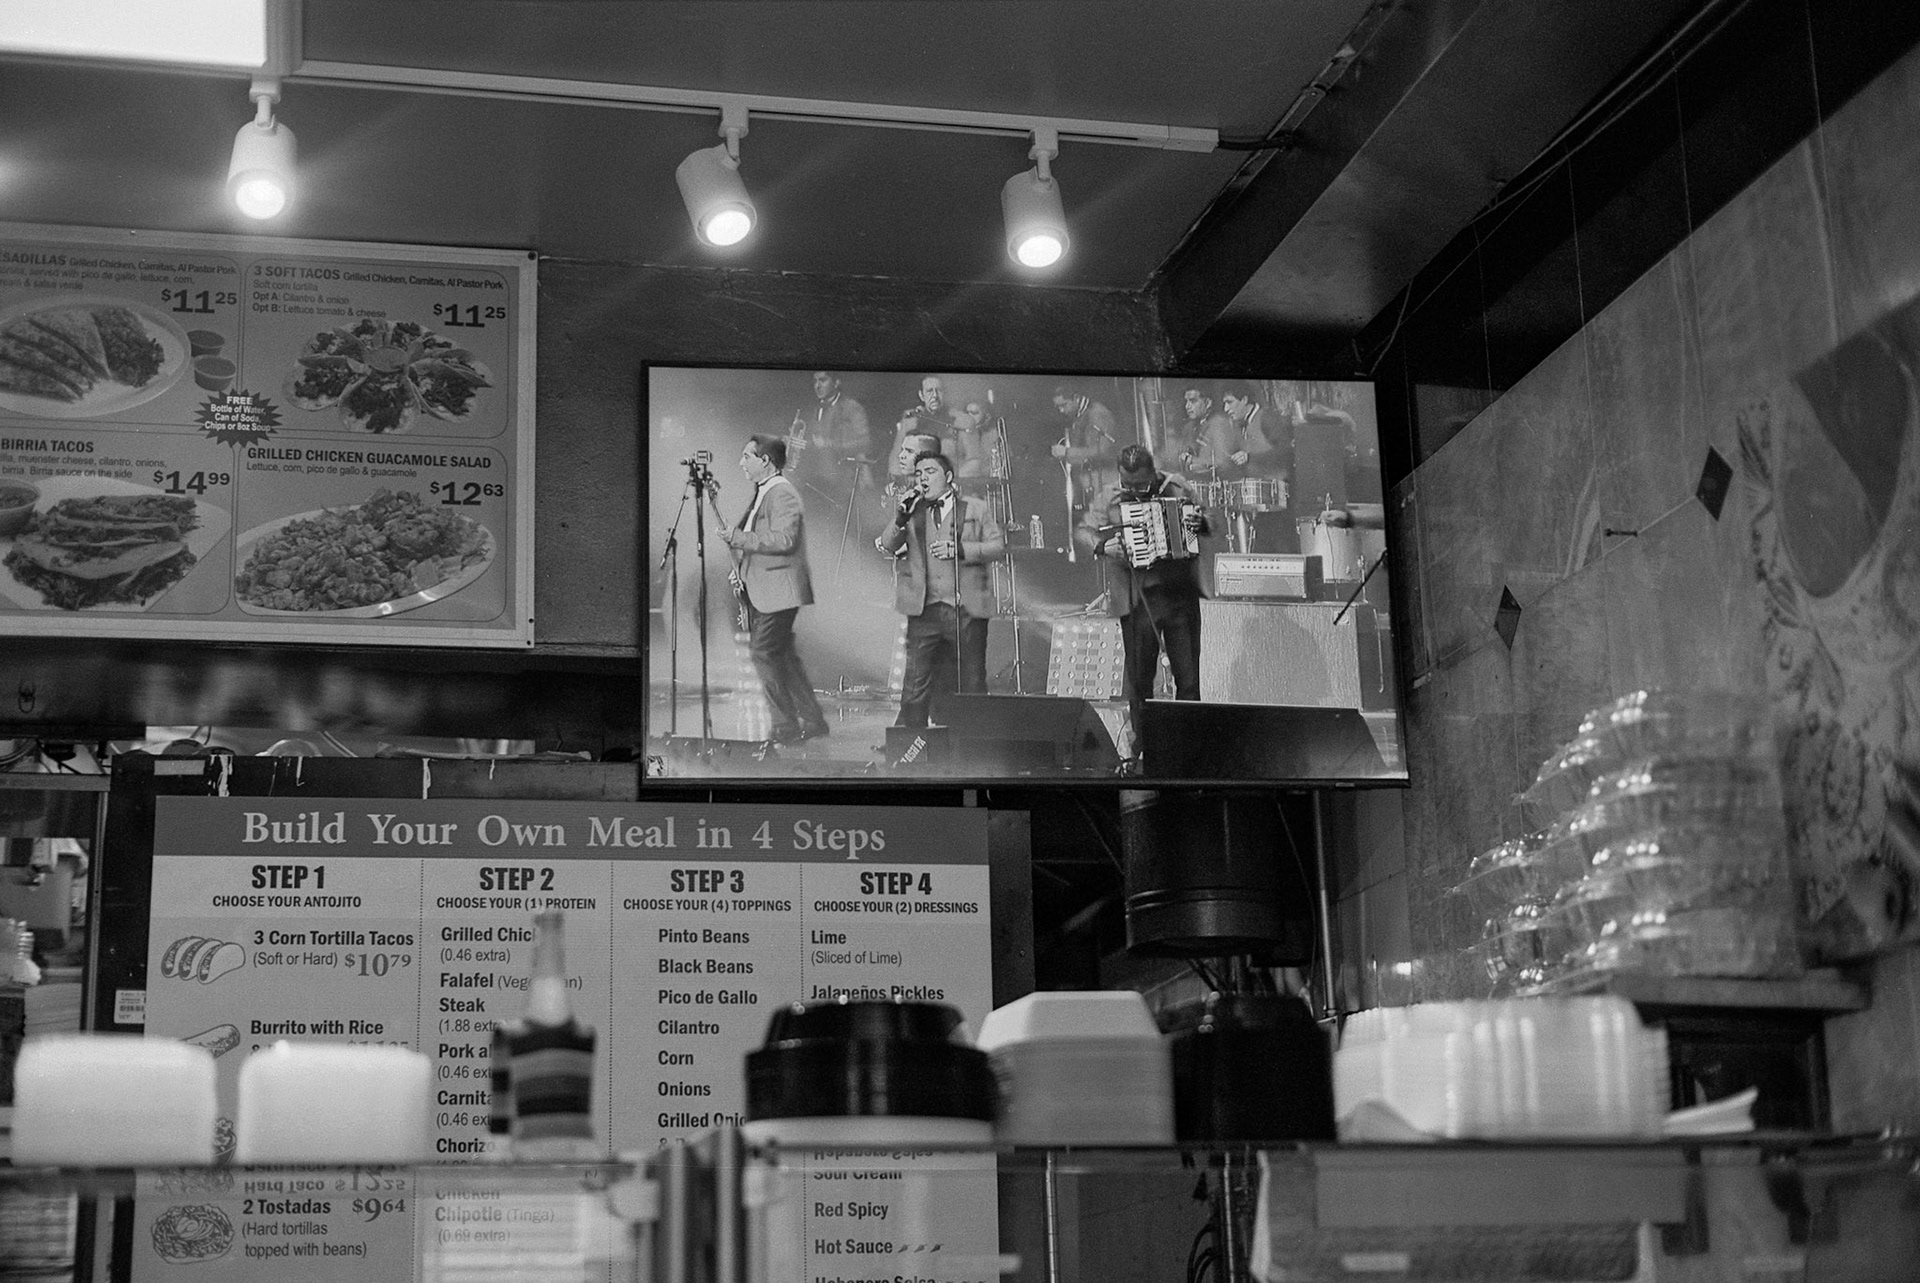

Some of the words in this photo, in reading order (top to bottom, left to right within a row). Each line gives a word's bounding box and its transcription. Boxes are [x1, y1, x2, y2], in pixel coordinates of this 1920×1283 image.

[188, 264, 216, 274] Pastor
[217, 265, 237, 275] Pork
[253, 265, 262, 276] 3
[265, 266, 297, 278] SOFT
[300, 267, 341, 280] TACOS
[343, 271, 371, 281] Grilled
[409, 275, 446, 287] Carnitas,
[447, 278, 456, 287] Al
[457, 278, 485, 289] Pastor
[485, 280, 504, 290] Pork
[253, 279, 271, 289] Soft
[272, 281, 291, 290] corn
[252, 291, 269, 302] Opt
[283, 293, 316, 303] Cilantro
[317, 294, 325, 303] &
[252, 302, 269, 313] Opt
[283, 304, 315, 314] Lettuce
[316, 306, 346, 316] tomato
[347, 307, 355, 317] &
[356, 308, 387, 318] cheese
[226, 395, 254, 405] FREE
[210, 404, 233, 413] Bottle
[233, 405, 242, 413] of
[214, 412, 230, 421] Can
[231, 413, 240, 421] of
[204, 420, 226, 431] Chips
[237, 422, 250, 431] 8oz
[251, 422, 271, 432] Soup
[0, 438, 48, 452] BIRRIA
[50, 440, 94, 453] TACOS
[135, 458, 167, 469] onions,
[247, 447, 302, 460] GRILLED
[305, 449, 363, 463] CHICKEN
[366, 452, 447, 467] GUACAMOLE
[450, 455, 492, 469] SALAD
[55, 468, 82, 477] sauce
[84, 469, 96, 477] on
[98, 468, 112, 478] the
[114, 469, 133, 479] side
[246, 461, 281, 473] Lettuce,
[283, 463, 305, 474] corn,
[306, 464, 325, 475] pico
[326, 465, 338, 474] de
[339, 466, 360, 477] gallo
[362, 466, 369, 475] &
[370, 467, 417, 479] guacamole
[242, 810, 347, 844] Build
[366, 813, 458, 845] Your
[477, 814, 567, 847] Own
[586, 816, 678, 849] Meal
[696, 818, 733, 849] in
[751, 820, 774, 849] 4
[793, 819, 886, 861] Steps
[251, 864, 308, 890] STEP
[313, 865, 325, 889] 1
[478, 866, 535, 891] STEP
[539, 867, 555, 891] 2
[670, 869, 725, 894] STEP
[729, 869, 745, 894] 3
[859, 871, 914, 895] STEP
[917, 871, 933, 895] 4
[213, 895, 265, 908] CHOOSE
[267, 896, 301, 908] YOUR
[303, 896, 362, 908] ANTOJITO
[436, 896, 488, 909] CHOOSE
[488, 897, 522, 909] YOUR
[524, 897, 543, 911] (1)
[545, 897, 596, 911] PROTEIN
[623, 898, 673, 911] CHOOSE
[674, 899, 709, 911] YOUR
[711, 898, 730, 913] (4)
[732, 899, 792, 912] TOPPINGS
[814, 901, 862, 913] CHOOSE
[862, 901, 893, 913] YOUR
[895, 901, 912, 915] (2)
[914, 902, 979, 914] DRESSINGS
[253, 930, 265, 945] 3
[269, 930, 306, 945] Corn
[309, 930, 365, 946] Tortilla
[369, 930, 414, 946] Tacos
[441, 926, 493, 942] Grilled
[658, 928, 698, 943] Pinto
[702, 928, 750, 944] Beans
[811, 929, 847, 945] Lime
[252, 951, 283, 968] (Soft
[286, 954, 299, 965] or
[303, 951, 338, 968] Hard)
[440, 947, 472, 965] (0.46
[475, 947, 511, 965] extra)
[811, 950, 851, 967] (Sliced
[854, 950, 867, 964] of
[869, 950, 903, 967] Lime)
[658, 958, 702, 974] Black
[706, 958, 754, 974] Beans
[440, 972, 494, 988] Falafel
[658, 989, 691, 1004] Pico
[695, 989, 714, 1005] de
[718, 989, 758, 1005] Gallo
[811, 984, 887, 1000] Jalapeños
[890, 985, 945, 1000] Pickles
[438, 997, 486, 1013] Steak
[250, 1019, 307, 1035] Burrito
[310, 1019, 344, 1035] with
[348, 1019, 384, 1035] Rice
[438, 1018, 470, 1035] (1.88
[657, 1019, 720, 1035] Cilantro
[438, 1043, 475, 1059] Pork
[657, 1049, 694, 1066] Corn
[437, 1065, 470, 1082] (0.46
[657, 1081, 711, 1097] Onions
[436, 1112, 468, 1129] (0.46
[657, 1112, 709, 1128] Grilled
[242, 1199, 254, 1214] 2
[257, 1198, 331, 1215] Tostadas
[814, 1202, 844, 1217] Red
[847, 1201, 889, 1220] Spicy
[435, 1205, 502, 1225] Chipotle
[506, 1208, 555, 1224] (Tinga)
[241, 1221, 278, 1239] (Hard
[281, 1221, 328, 1236] tortillas
[244, 1242, 290, 1260] topped
[292, 1242, 319, 1257] with
[322, 1241, 367, 1259] beans)
[814, 1239, 842, 1254] Hot
[845, 1238, 893, 1254] Sauce
